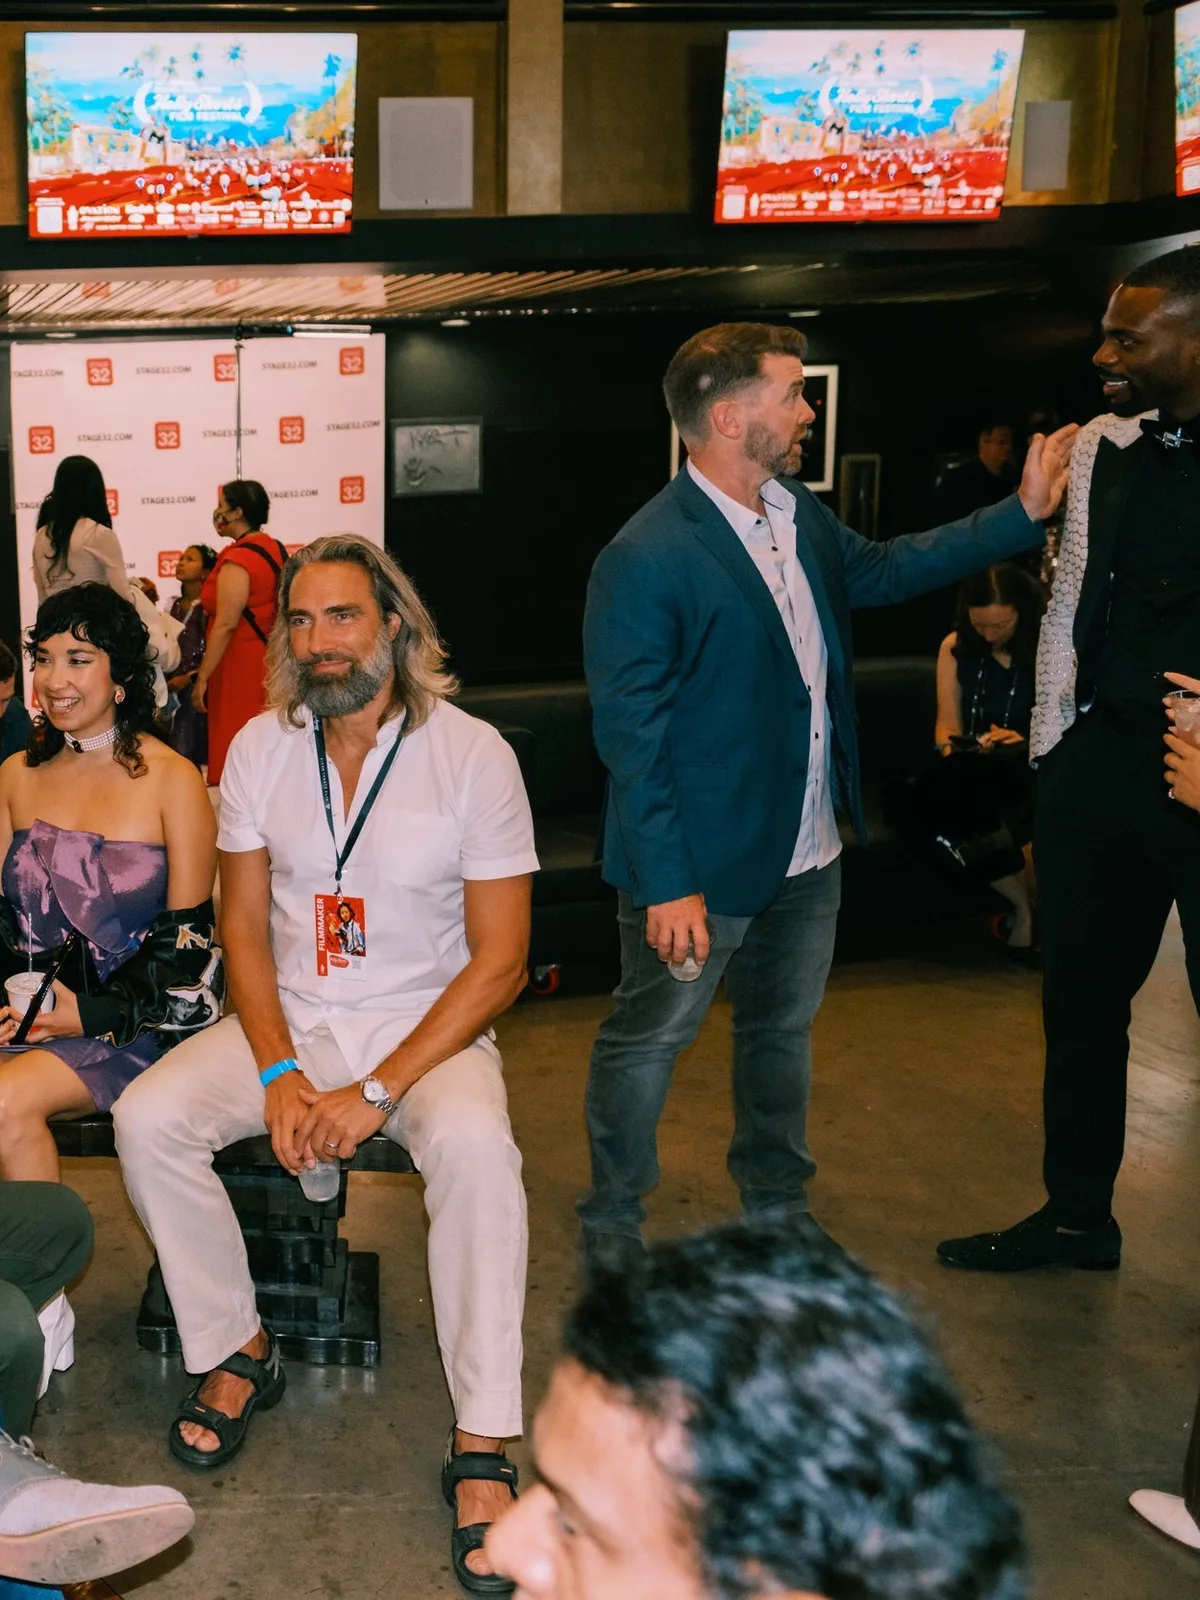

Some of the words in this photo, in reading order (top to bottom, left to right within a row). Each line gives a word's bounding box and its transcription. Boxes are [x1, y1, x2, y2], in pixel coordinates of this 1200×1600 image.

[216, 362, 237, 379] 32
[343, 356, 362, 372] 32
[12, 368, 64, 378] TAGE32.COM
[90, 366, 111, 383] 32
[158, 430, 178, 447] 32
[282, 425, 302, 441] 32
[31, 435, 53, 452] 32
[141, 496, 196, 505] STAGE32.COM
[269, 489, 319, 499] TAGE32.COM
[343, 485, 362, 501] 32
[316, 897, 326, 952] FILMMAKER
